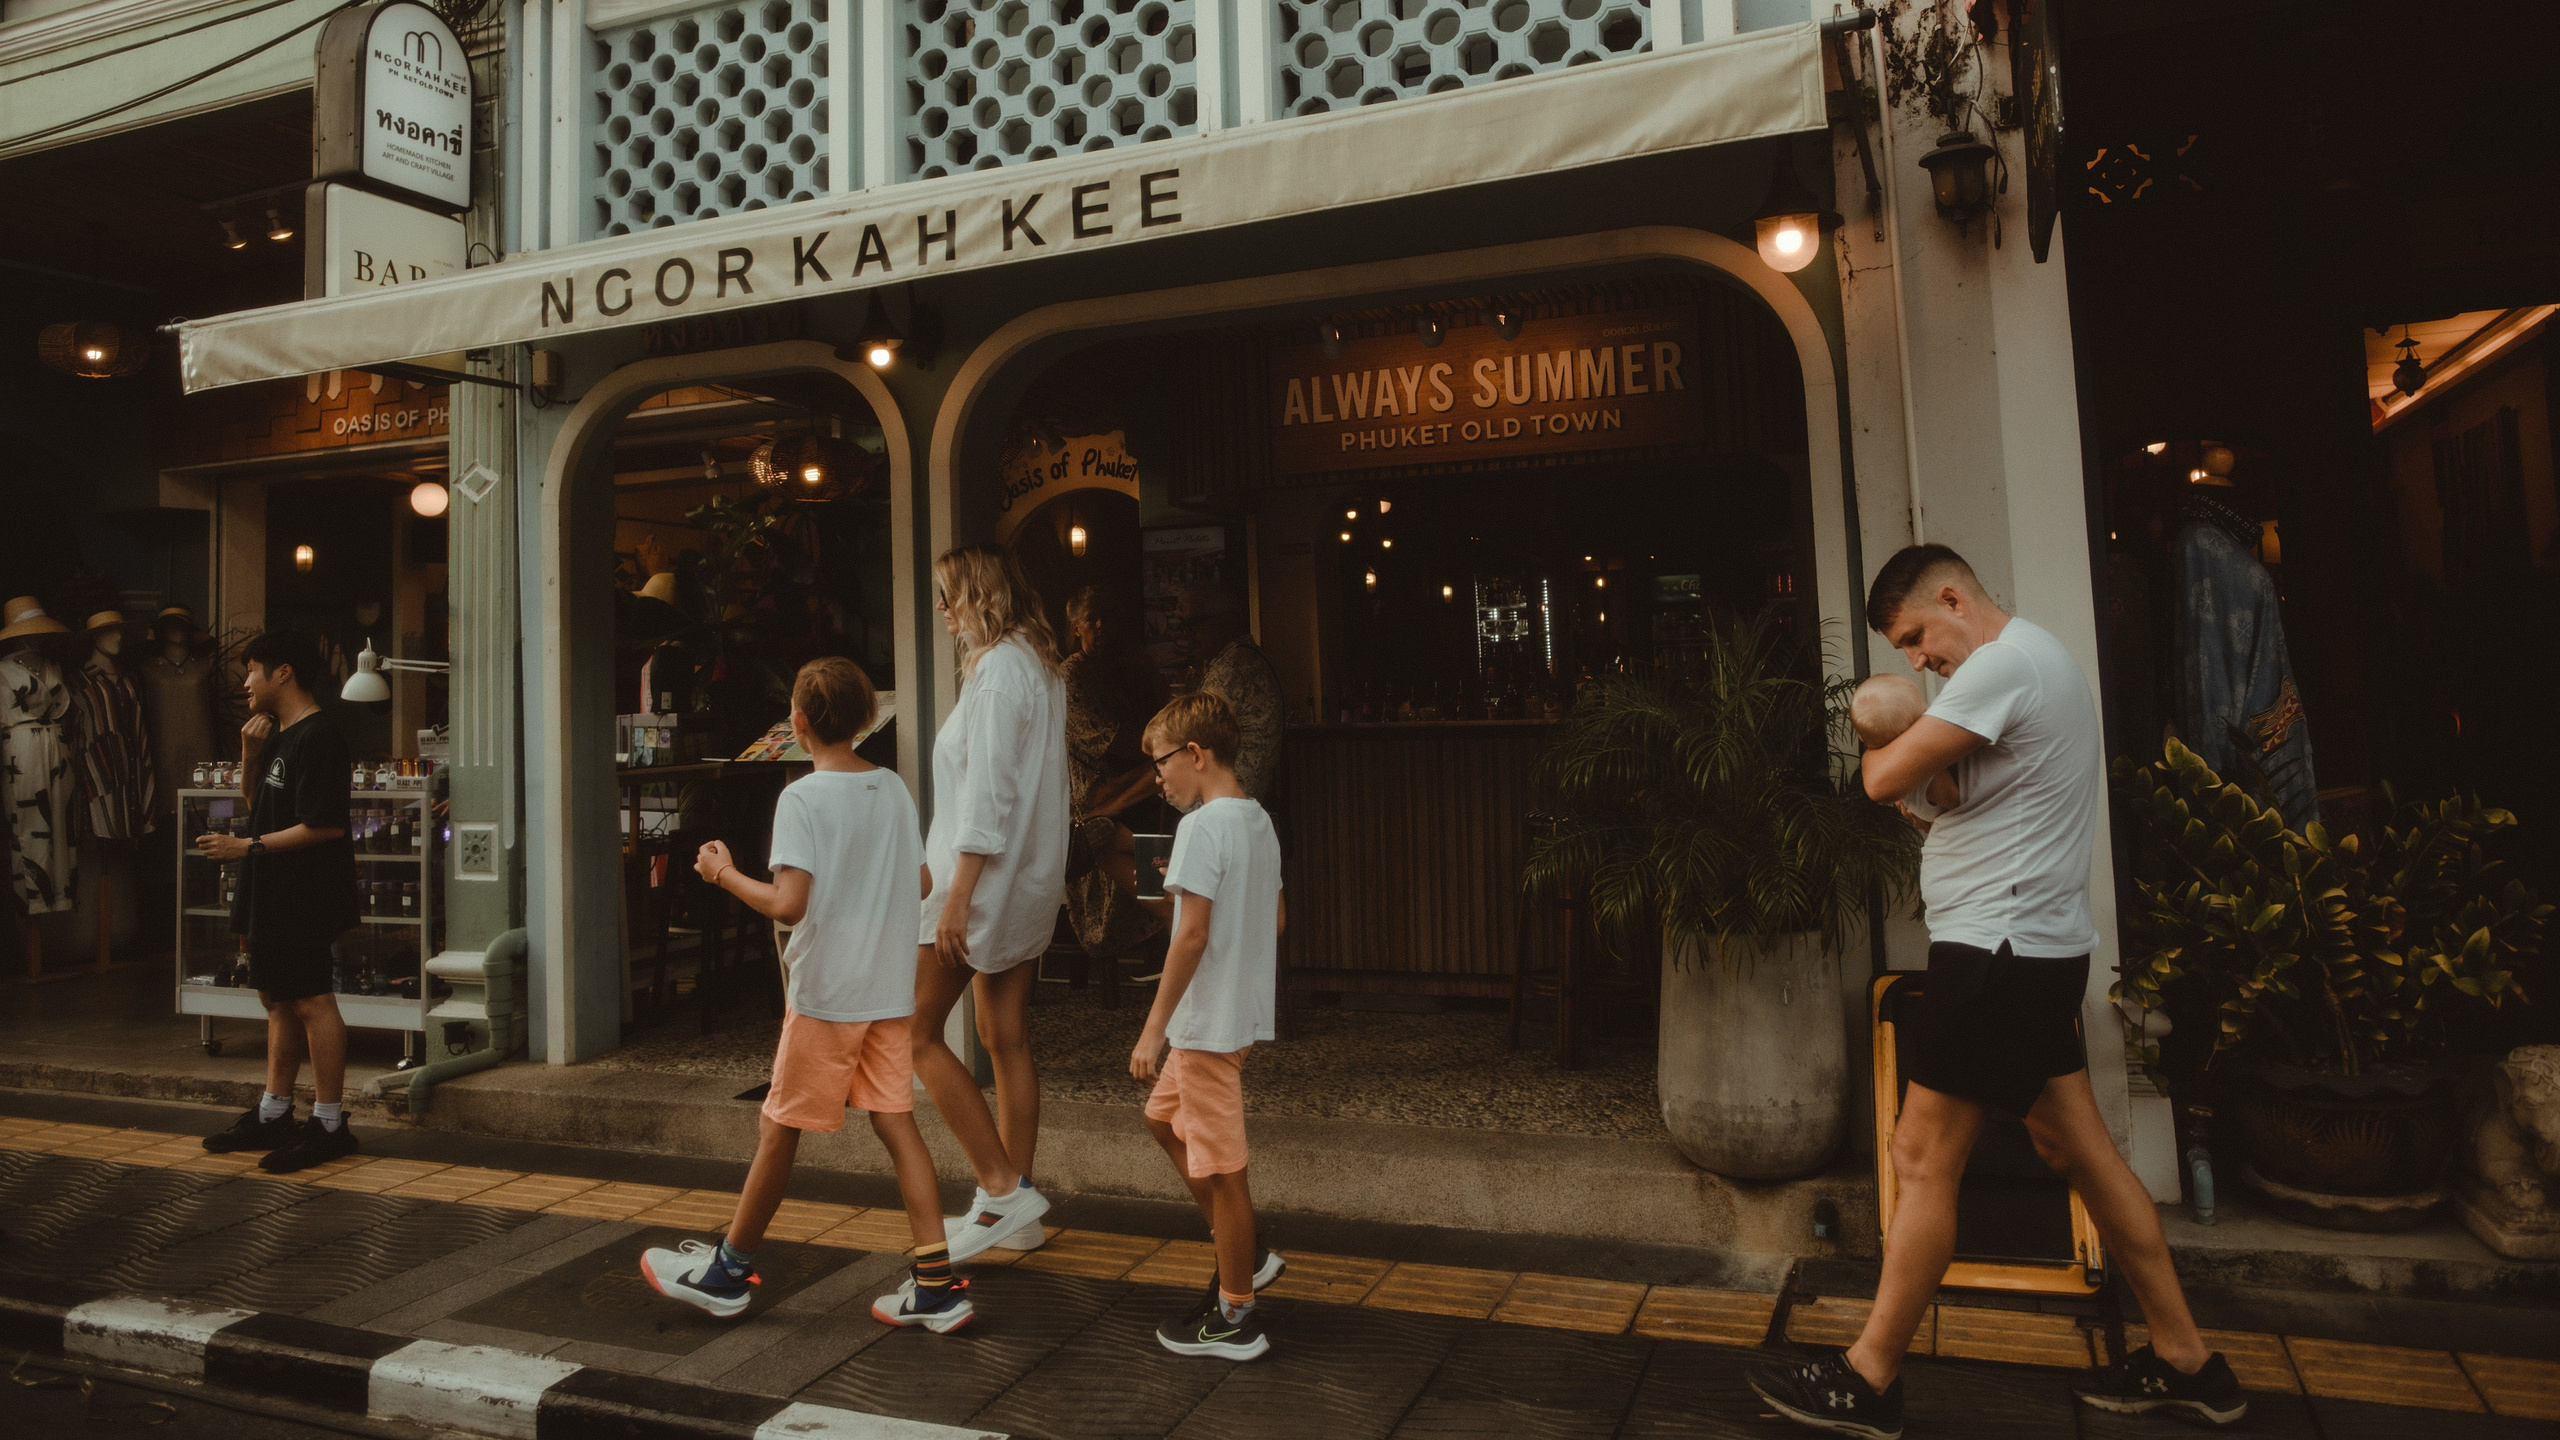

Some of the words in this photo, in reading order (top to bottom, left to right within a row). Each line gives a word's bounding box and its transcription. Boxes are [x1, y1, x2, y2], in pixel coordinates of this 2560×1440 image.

[374, 49, 411, 71] NGOR
[415, 66, 440, 83] KAH
[444, 78, 467, 95] KEE
[419, 80, 433, 90] OLD
[434, 86, 454, 99] TOWN
[382, 151, 394, 161] ART
[395, 156, 410, 166] AND
[410, 161, 430, 173] CRAFT
[430, 167, 455, 182] VILLAGE
[386, 142, 425, 161] HOMEMADE
[425, 155, 452, 170] KITCHEN
[541, 247, 754, 328] NGOR
[793, 209, 956, 287] KAH
[1001, 168, 1182, 252] KEE
[1282, 362, 1454, 426] ALWAYS
[1472, 340, 1685, 409] SUMMER
[333, 412, 391, 436] OASIS
[395, 409, 420, 428] OF
[1341, 422, 1453, 452] PHUKET
[1460, 417, 1522, 442] OLD
[1530, 408, 1622, 436] TOWN
[1050, 451, 1071, 480] of
[1081, 448, 1139, 483] Phuket
